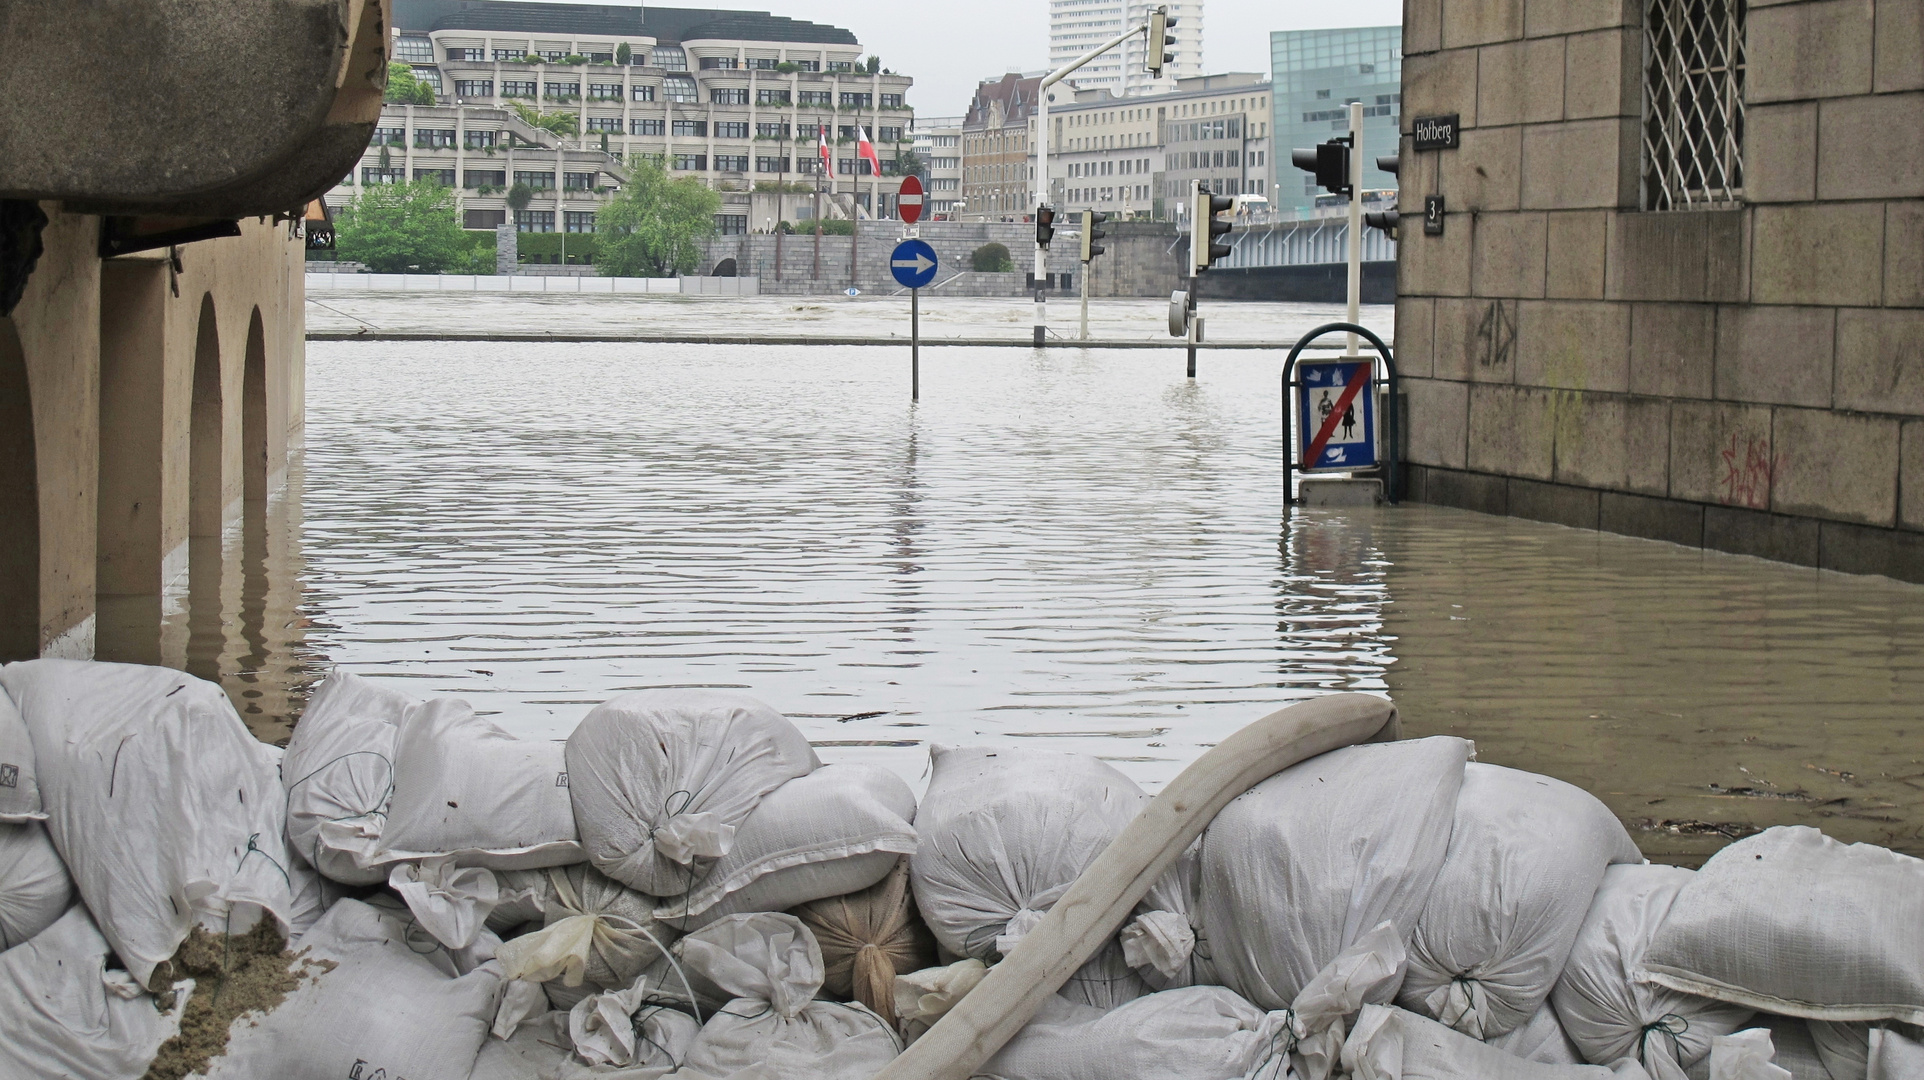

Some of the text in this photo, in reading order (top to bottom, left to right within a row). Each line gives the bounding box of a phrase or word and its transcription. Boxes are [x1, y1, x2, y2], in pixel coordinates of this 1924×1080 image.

[1416, 120, 1452, 145] Hofberg
[1429, 200, 1436, 220] 3
[560, 776, 568, 785] R
